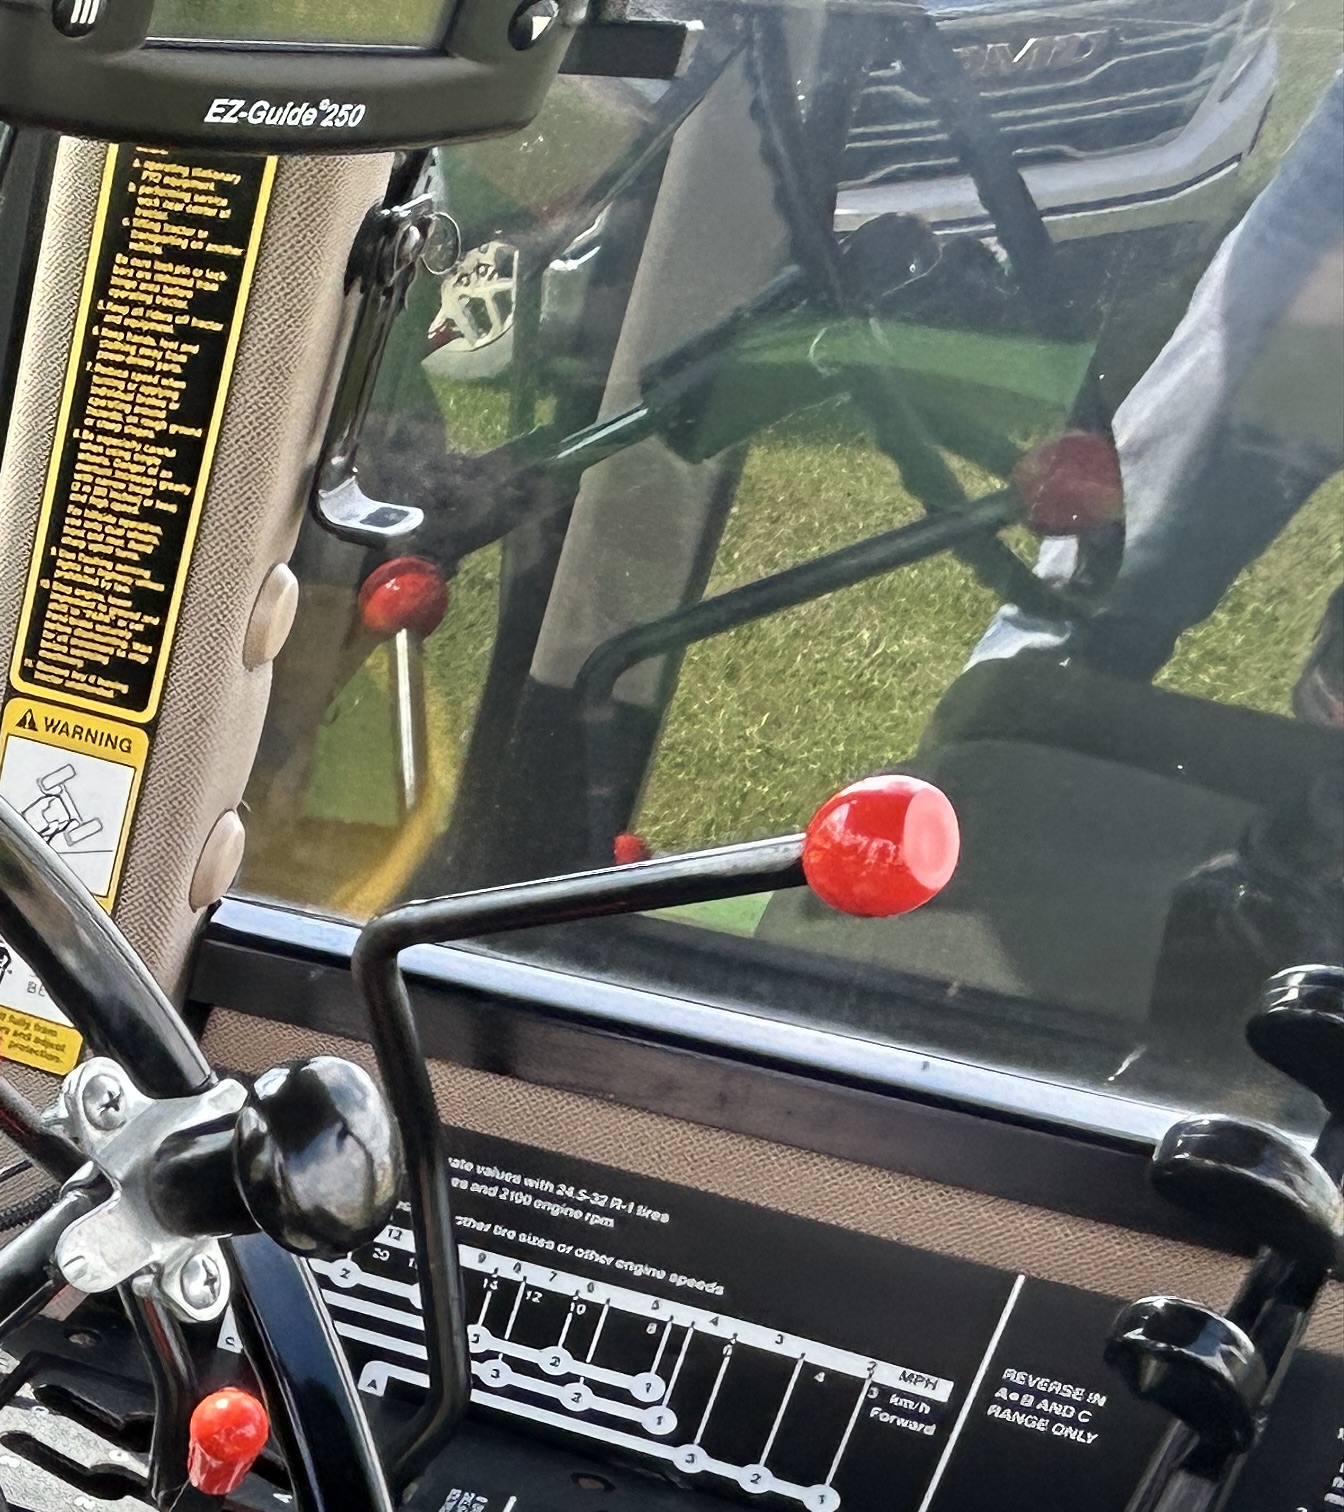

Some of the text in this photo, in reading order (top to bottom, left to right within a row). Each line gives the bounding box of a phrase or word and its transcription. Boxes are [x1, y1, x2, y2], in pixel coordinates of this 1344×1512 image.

[320, 103, 367, 128] 250
[43, 716, 133, 754] WARNING
[669, 1272, 725, 1296] speeds
[570, 1303, 587, 1315] 10
[898, 1370, 940, 1391] MPH
[1002, 1368, 1086, 1401] REVERSE
[869, 1407, 937, 1435] Forward
[1036, 1399, 1076, 1418] AND
[1078, 1410, 1093, 1423] C
[987, 1404, 1099, 1444] RANGE ONLY
